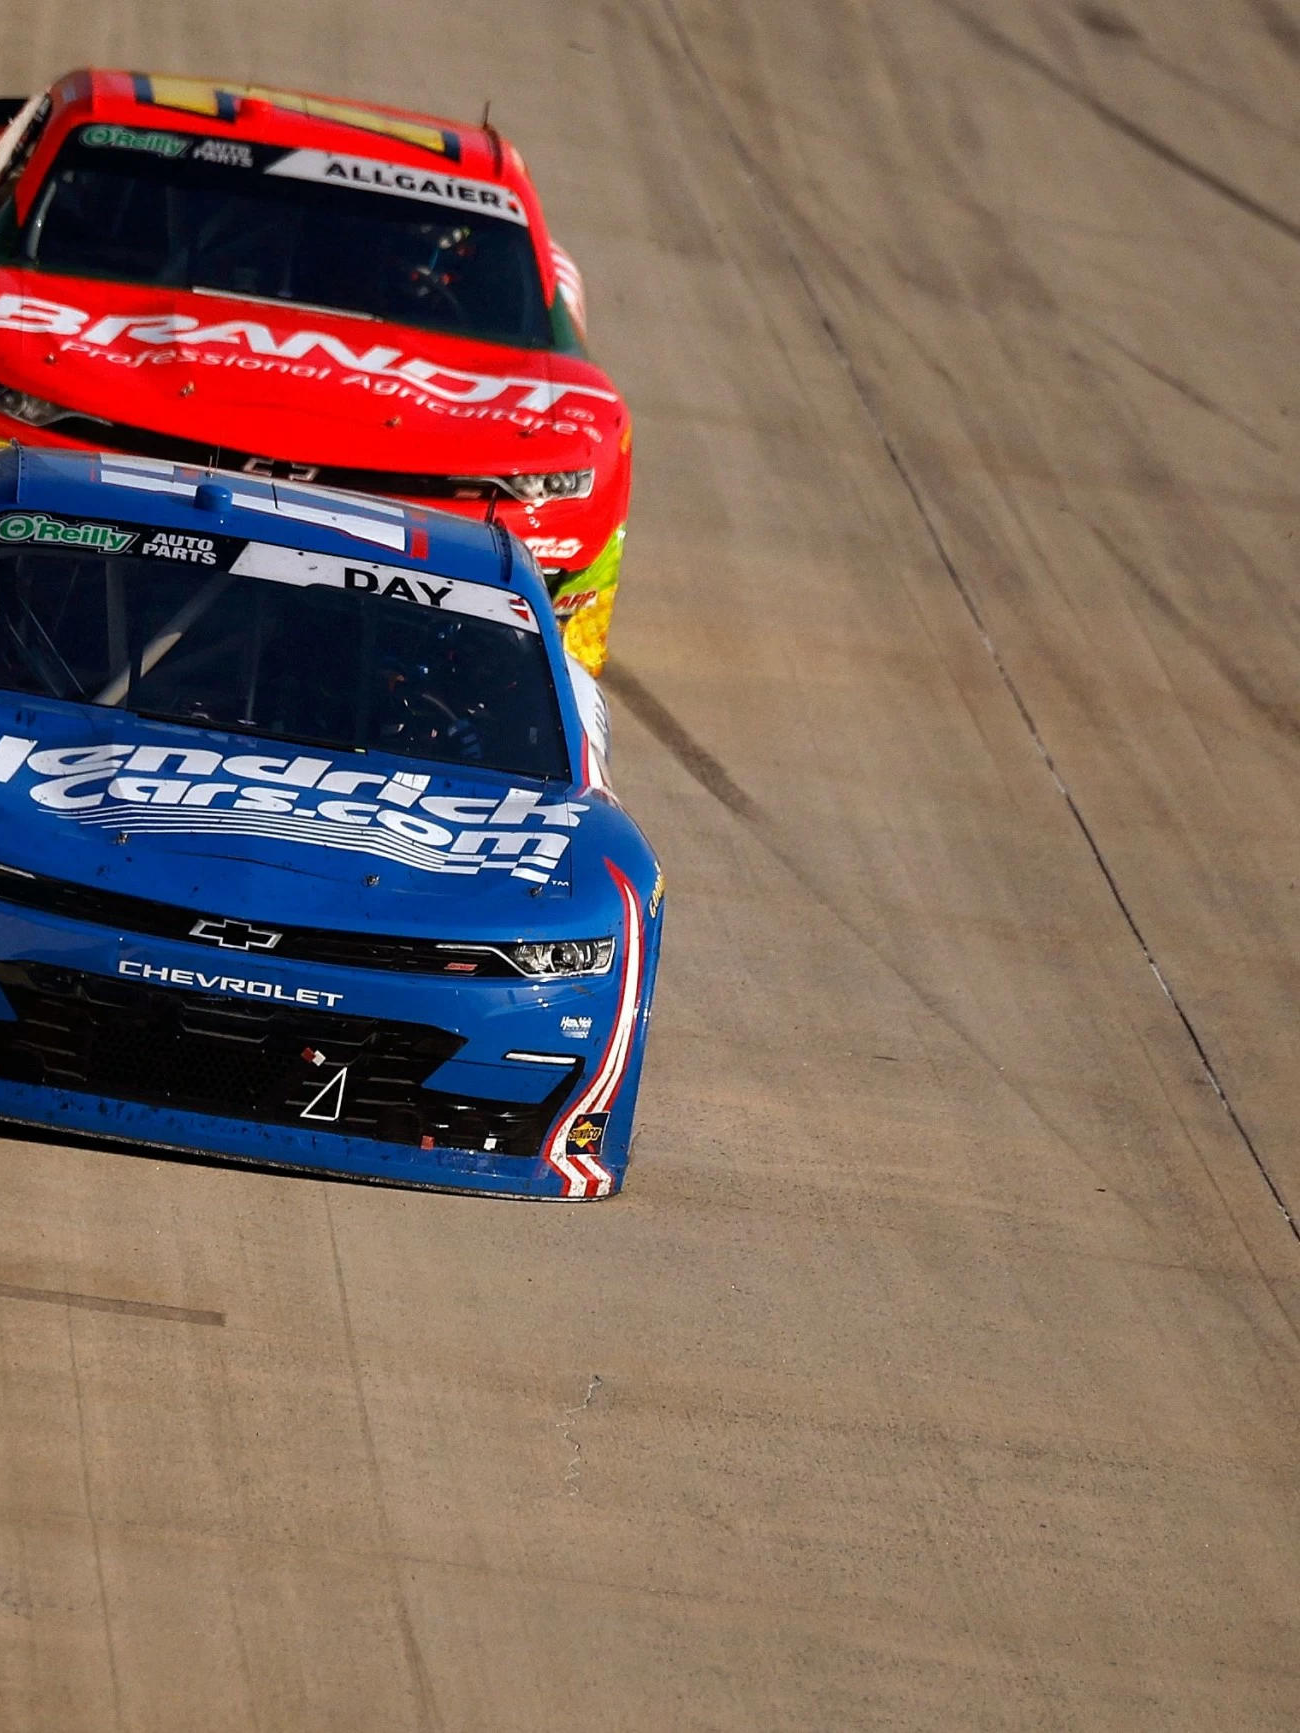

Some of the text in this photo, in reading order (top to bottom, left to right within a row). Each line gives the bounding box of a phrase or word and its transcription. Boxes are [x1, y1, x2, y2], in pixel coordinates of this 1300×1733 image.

[326, 163, 501, 208] ALLGAIER
[60, 341, 579, 435] Professional Agriculture
[142, 543, 217, 565] PARTS
[152, 532, 214, 552] AUTO
[344, 568, 453, 608] DAY
[29, 768, 571, 860] Cars.com
[118, 961, 344, 1007] CHEVROLET
